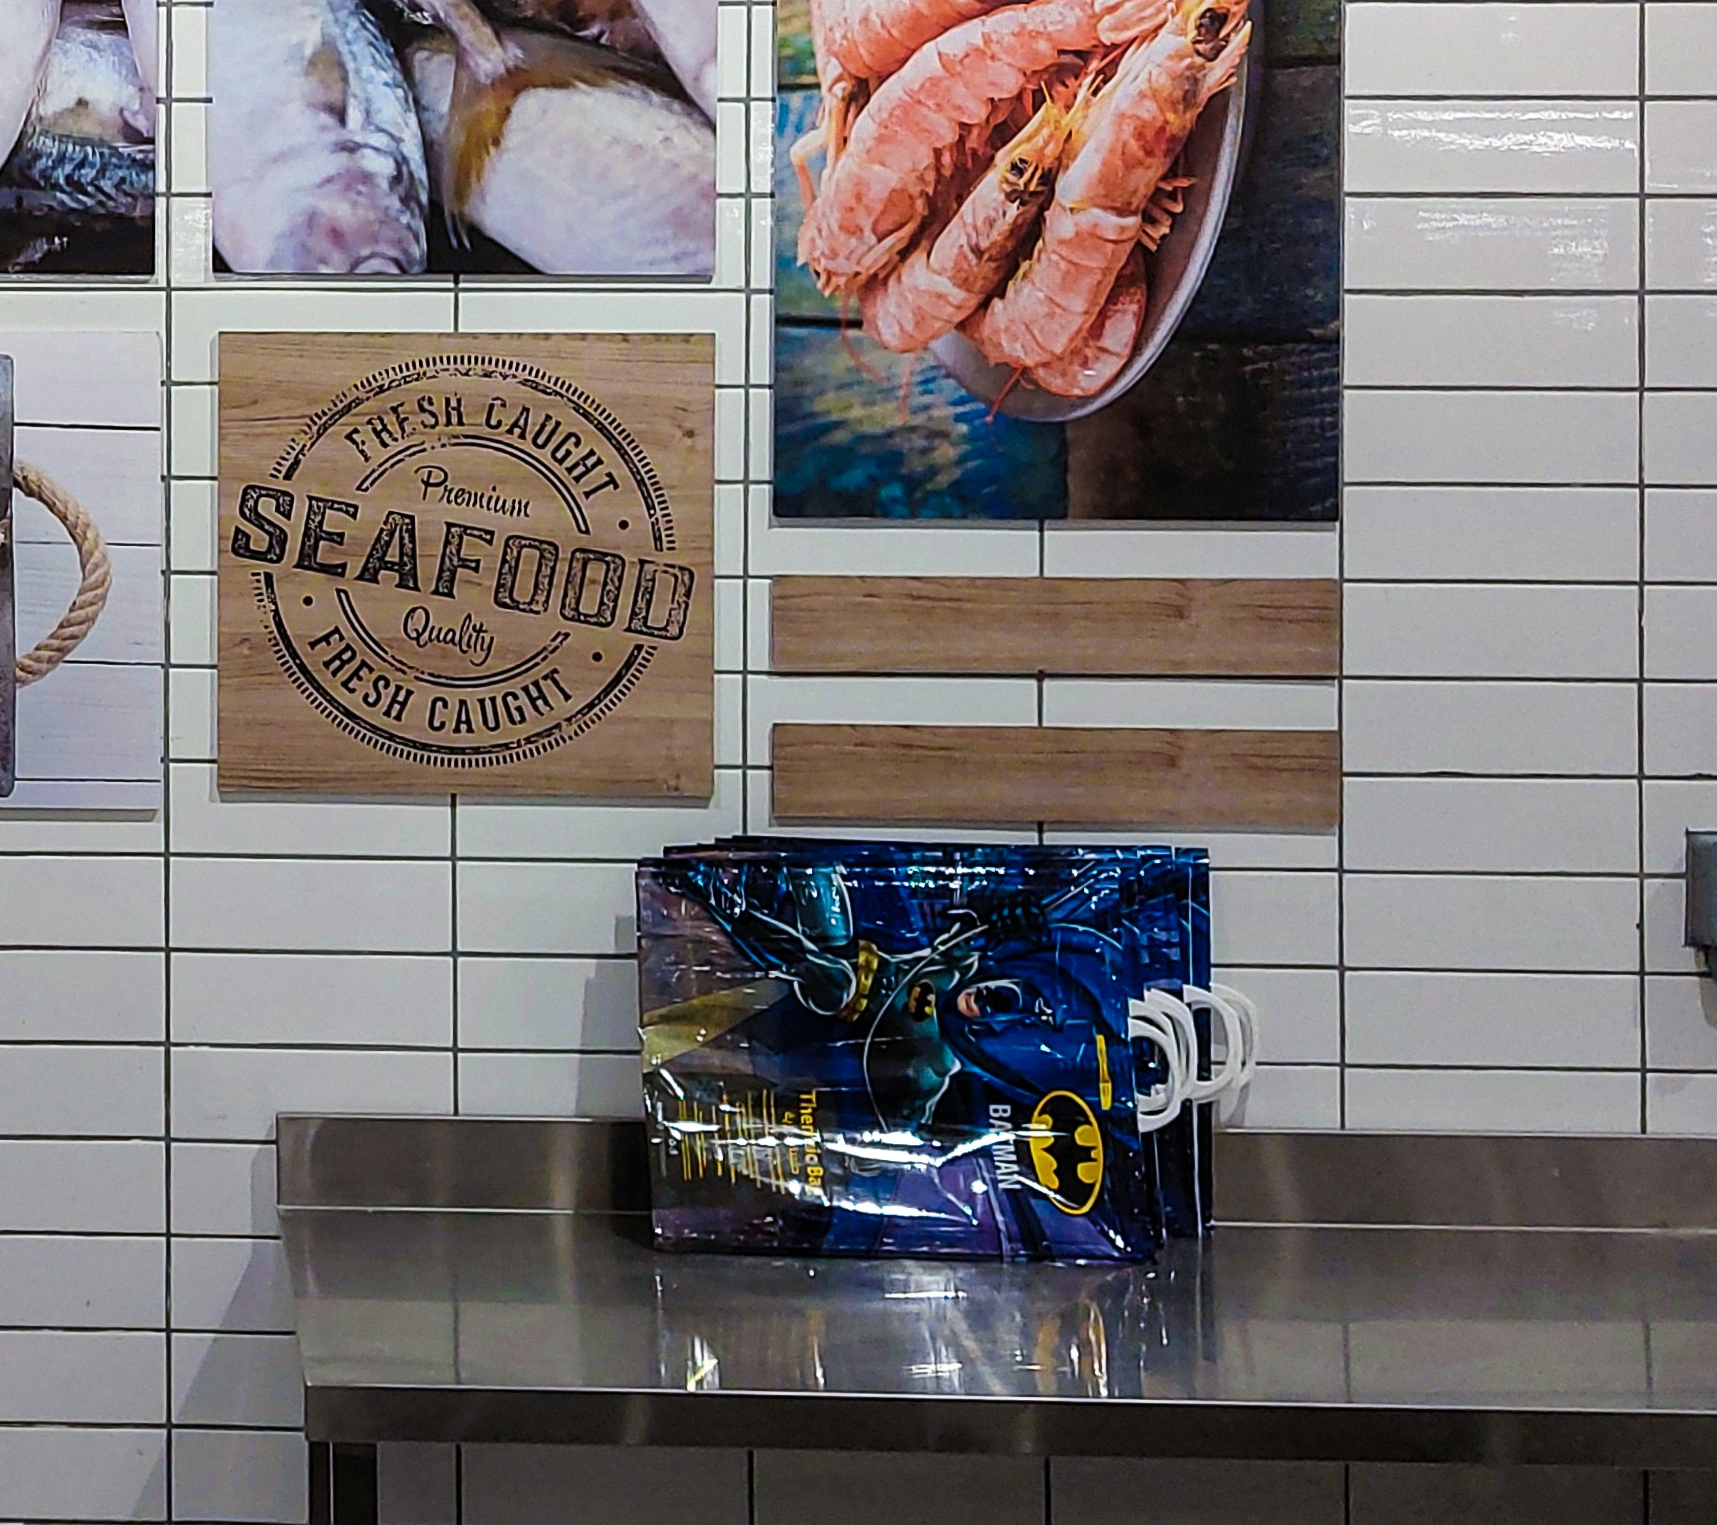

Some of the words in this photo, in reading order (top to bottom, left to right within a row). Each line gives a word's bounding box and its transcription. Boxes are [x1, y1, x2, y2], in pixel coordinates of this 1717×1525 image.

[344, 394, 465, 463] FRESH
[484, 396, 620, 501] CAUGHT
[413, 465, 531, 518] Premium
[231, 483, 695, 642] SEAFOOD
[308, 625, 416, 722] FRESH
[428, 668, 573, 734] CAUGHT
[402, 606, 496, 667] Quality
